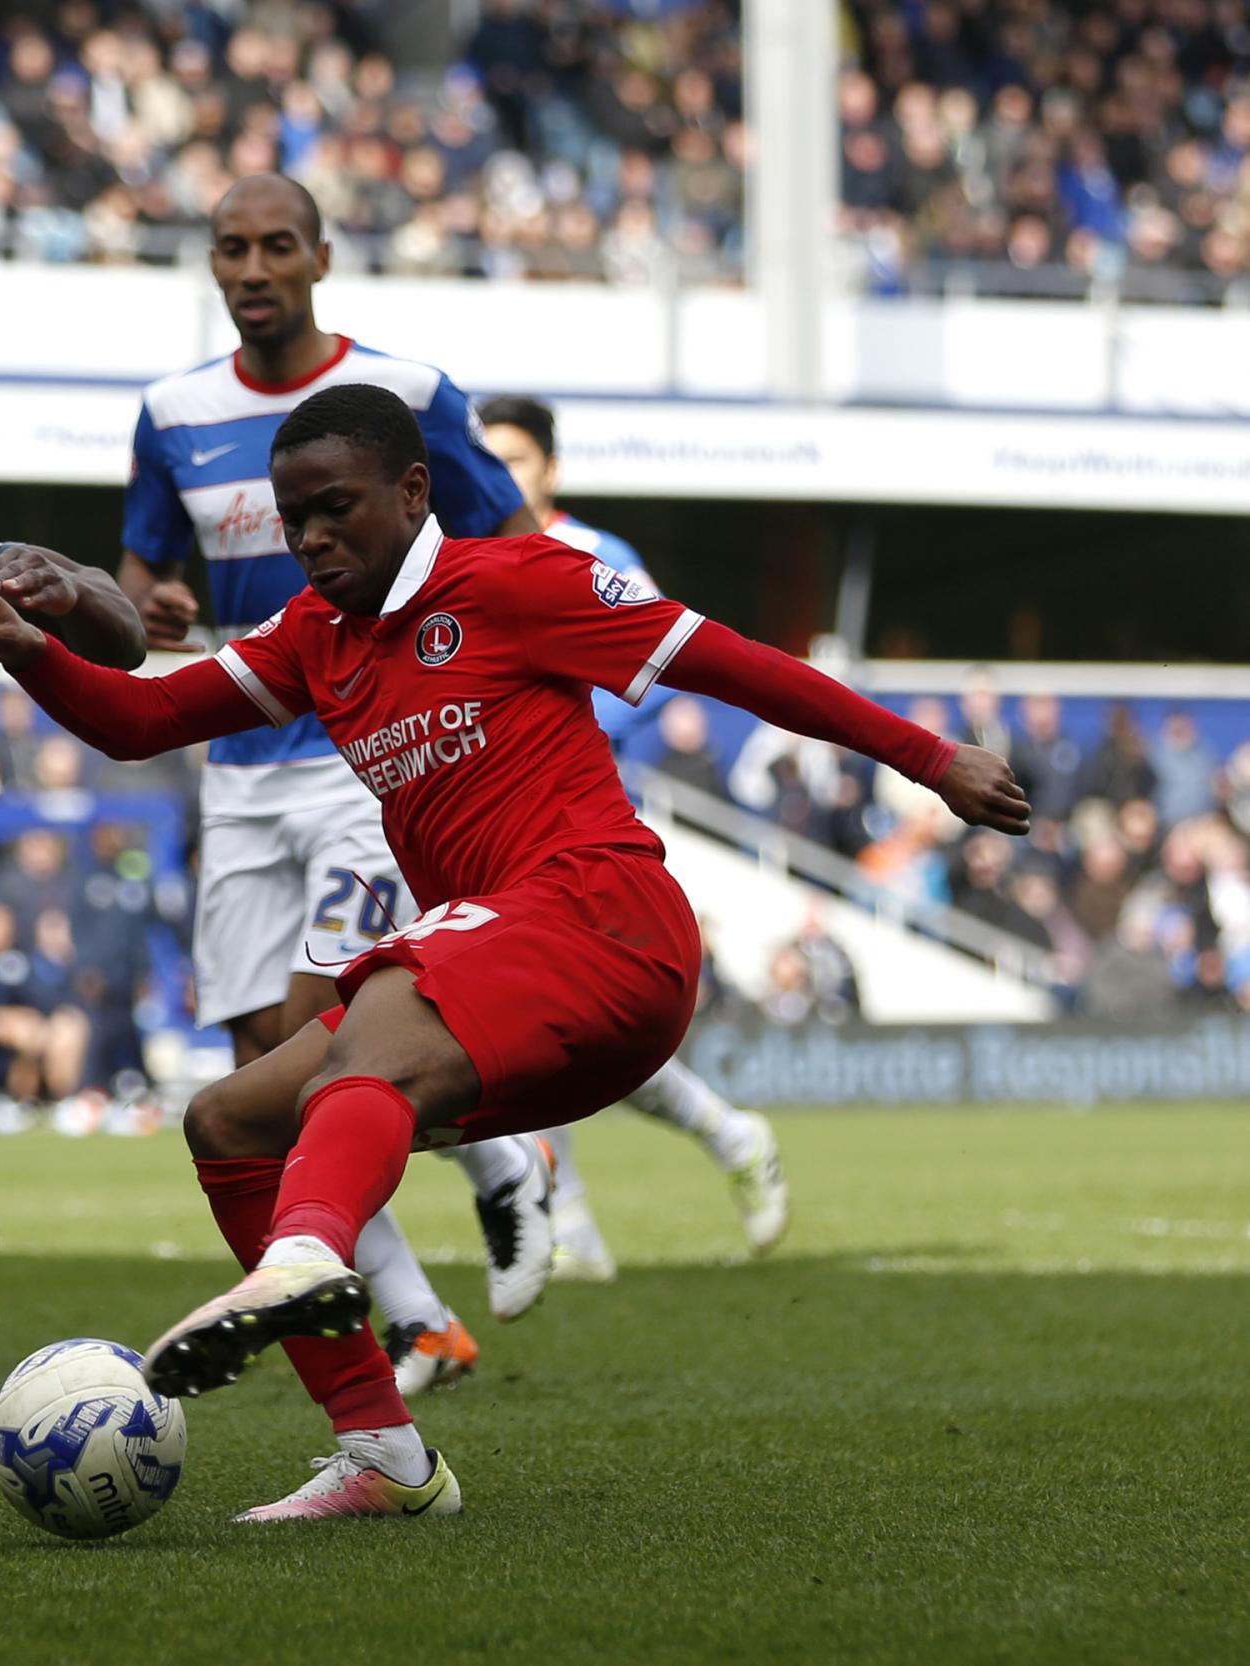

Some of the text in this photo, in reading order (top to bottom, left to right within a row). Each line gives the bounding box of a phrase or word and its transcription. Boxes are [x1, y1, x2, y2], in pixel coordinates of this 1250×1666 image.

[340, 702, 481, 767] NIVERSITY OF
[312, 867, 398, 941] 20
